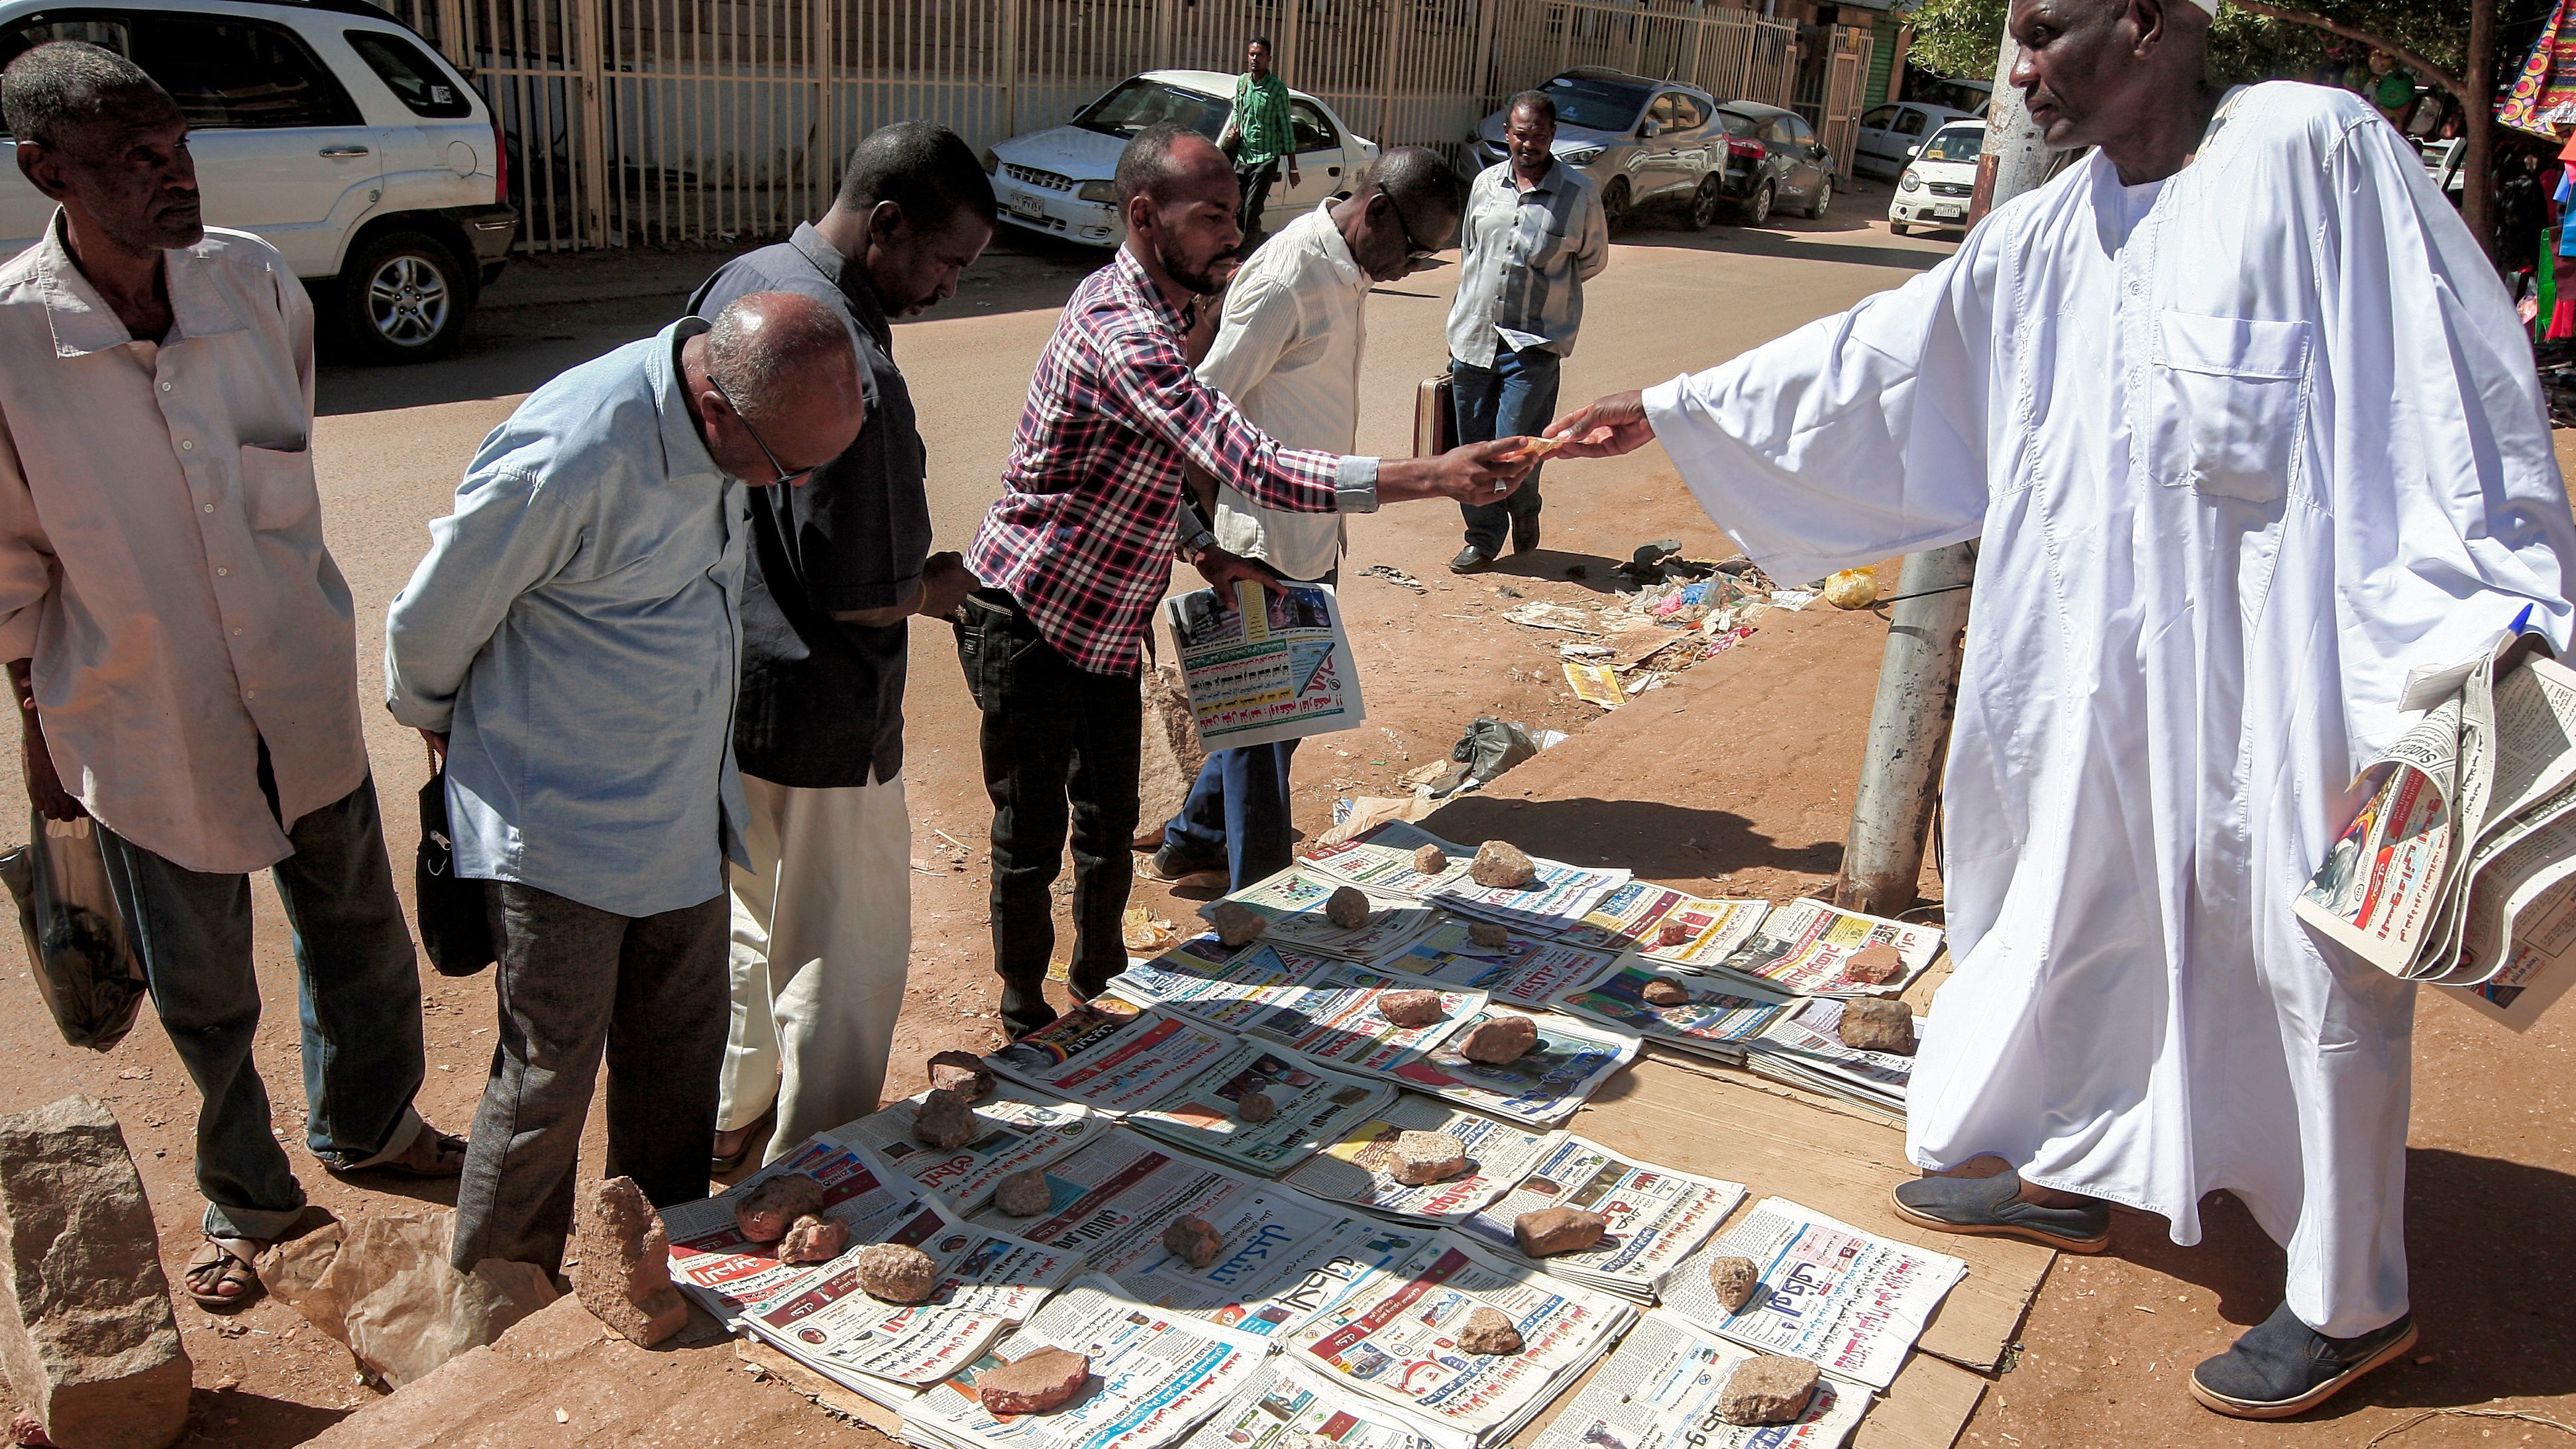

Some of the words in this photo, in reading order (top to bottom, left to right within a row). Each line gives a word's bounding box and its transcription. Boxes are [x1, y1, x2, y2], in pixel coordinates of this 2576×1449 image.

[1199, 714, 1220, 729] بايدن
[1221, 711, 1238, 724] يقول
[1238, 706, 1263, 724] لترامب
[2395, 743, 2438, 764] Sudan
[1065, 1024, 1114, 1051] بايدين
[1083, 1075, 1124, 1099] السوداني
[1275, 1128, 1313, 1150] الشرق
[694, 1249, 761, 1283] الجريد
[1206, 1224, 1293, 1285] تشكيل
[737, 1273, 766, 1285] المتحدة
[754, 1275, 784, 1289] الرئيس
[1763, 1262, 1832, 1317] الوفاق
[890, 1332, 924, 1353] المختصة
[991, 1247, 1025, 1273] المواصلات
[918, 1329, 949, 1350] حمدوك
[940, 1312, 967, 1330] بصحة
[997, 1267, 1024, 1286] مهامه
[1530, 1305, 1554, 1320] تحسم
[1546, 1301, 1577, 1321] بالعاصمة
[933, 1336, 969, 1360] للسودان
[1112, 1404, 1136, 1422] العام
[1142, 1383, 1163, 1399] يملك
[1172, 1358, 1195, 1375] يقدمه
[1118, 1409, 1146, 1430] مليون
[1160, 1383, 1183, 1401] لشراء
[1179, 1371, 1199, 1386] قمح
[1195, 1346, 1226, 1373] للسودان
[1136, 1408, 1170, 1434] جازولين
[1168, 1394, 1193, 1412] للبيع
[1189, 1373, 1219, 1397] بالسعر
[1215, 1352, 1245, 1376] الجديد
[1454, 1383, 1476, 1398] مثيرة
[1468, 1371, 1489, 1386] يدلي
